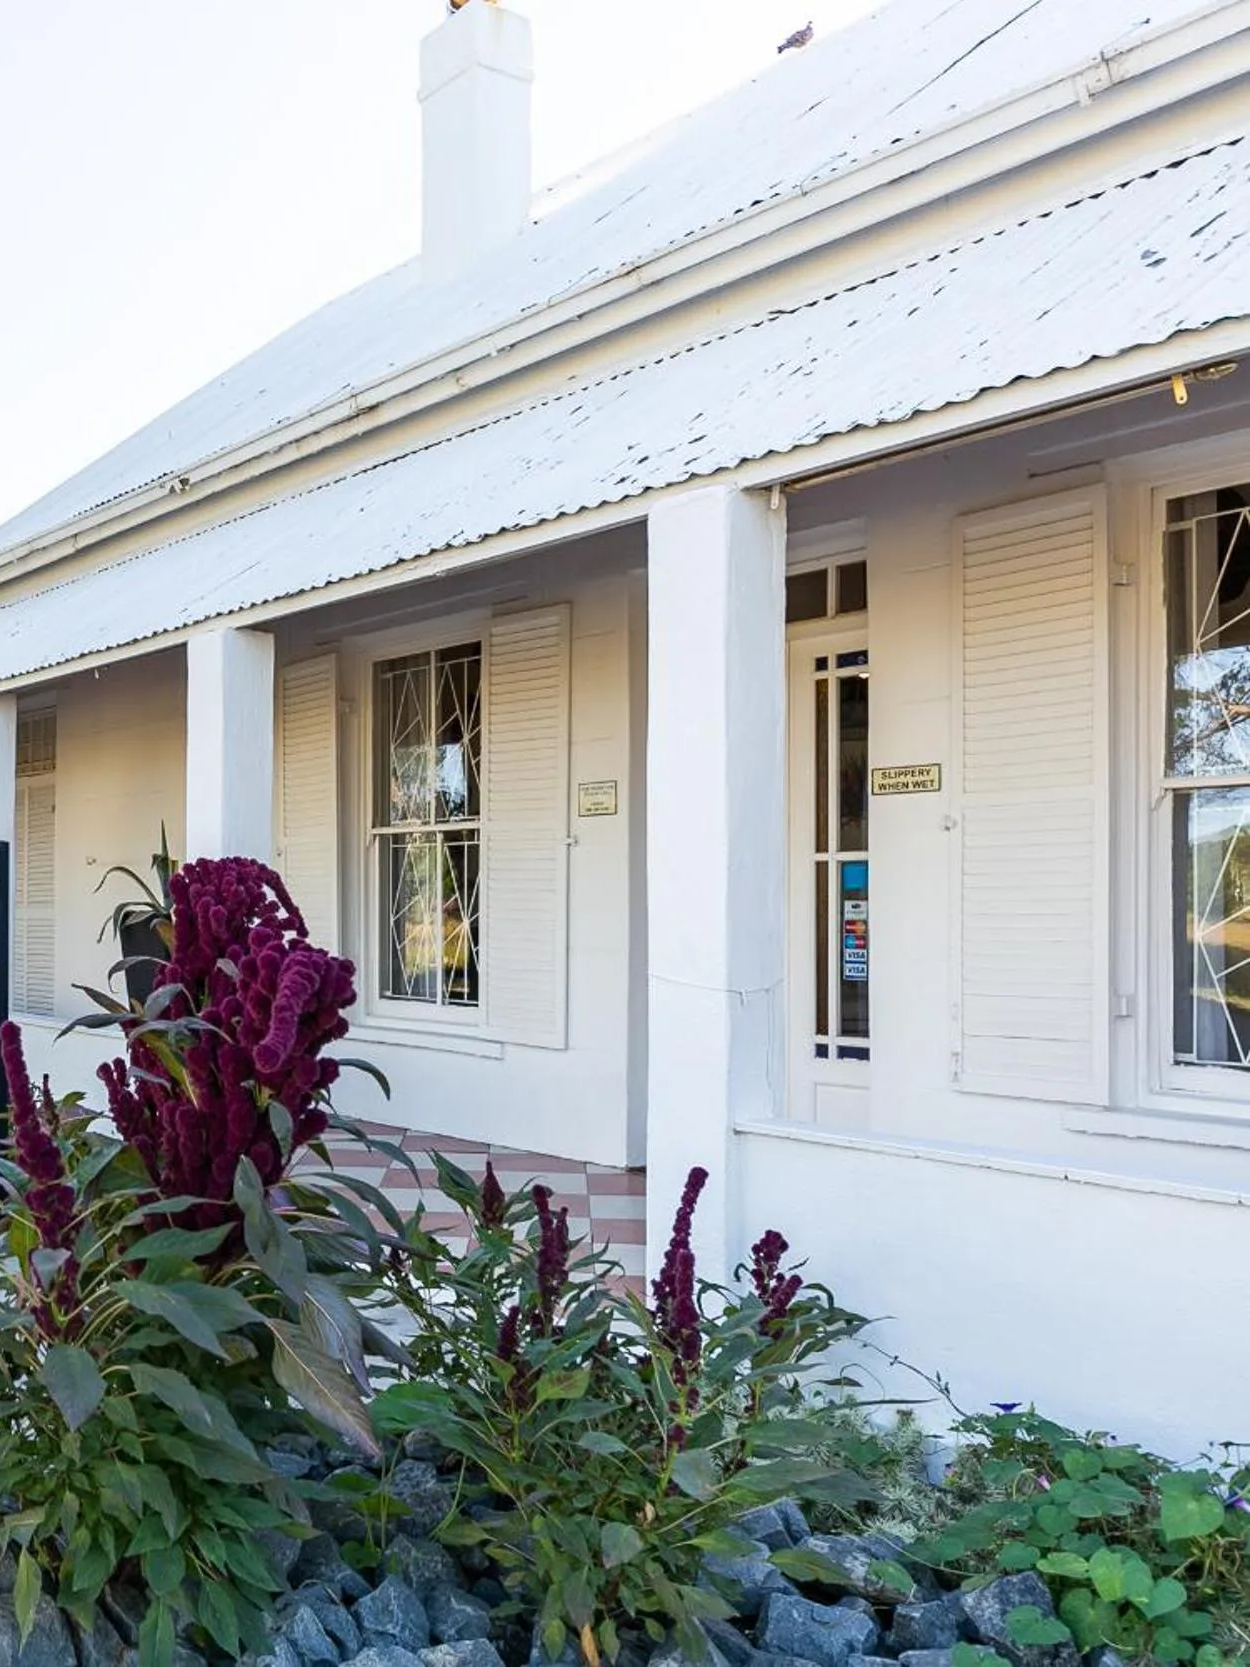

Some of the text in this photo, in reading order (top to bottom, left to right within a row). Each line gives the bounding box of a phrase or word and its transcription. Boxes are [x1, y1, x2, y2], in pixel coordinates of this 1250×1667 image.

[881, 768, 932, 780] SLIPPERY
[878, 779, 935, 791] WHEN WET
[847, 951, 866, 960] VISA
[847, 966, 866, 974] VISA
